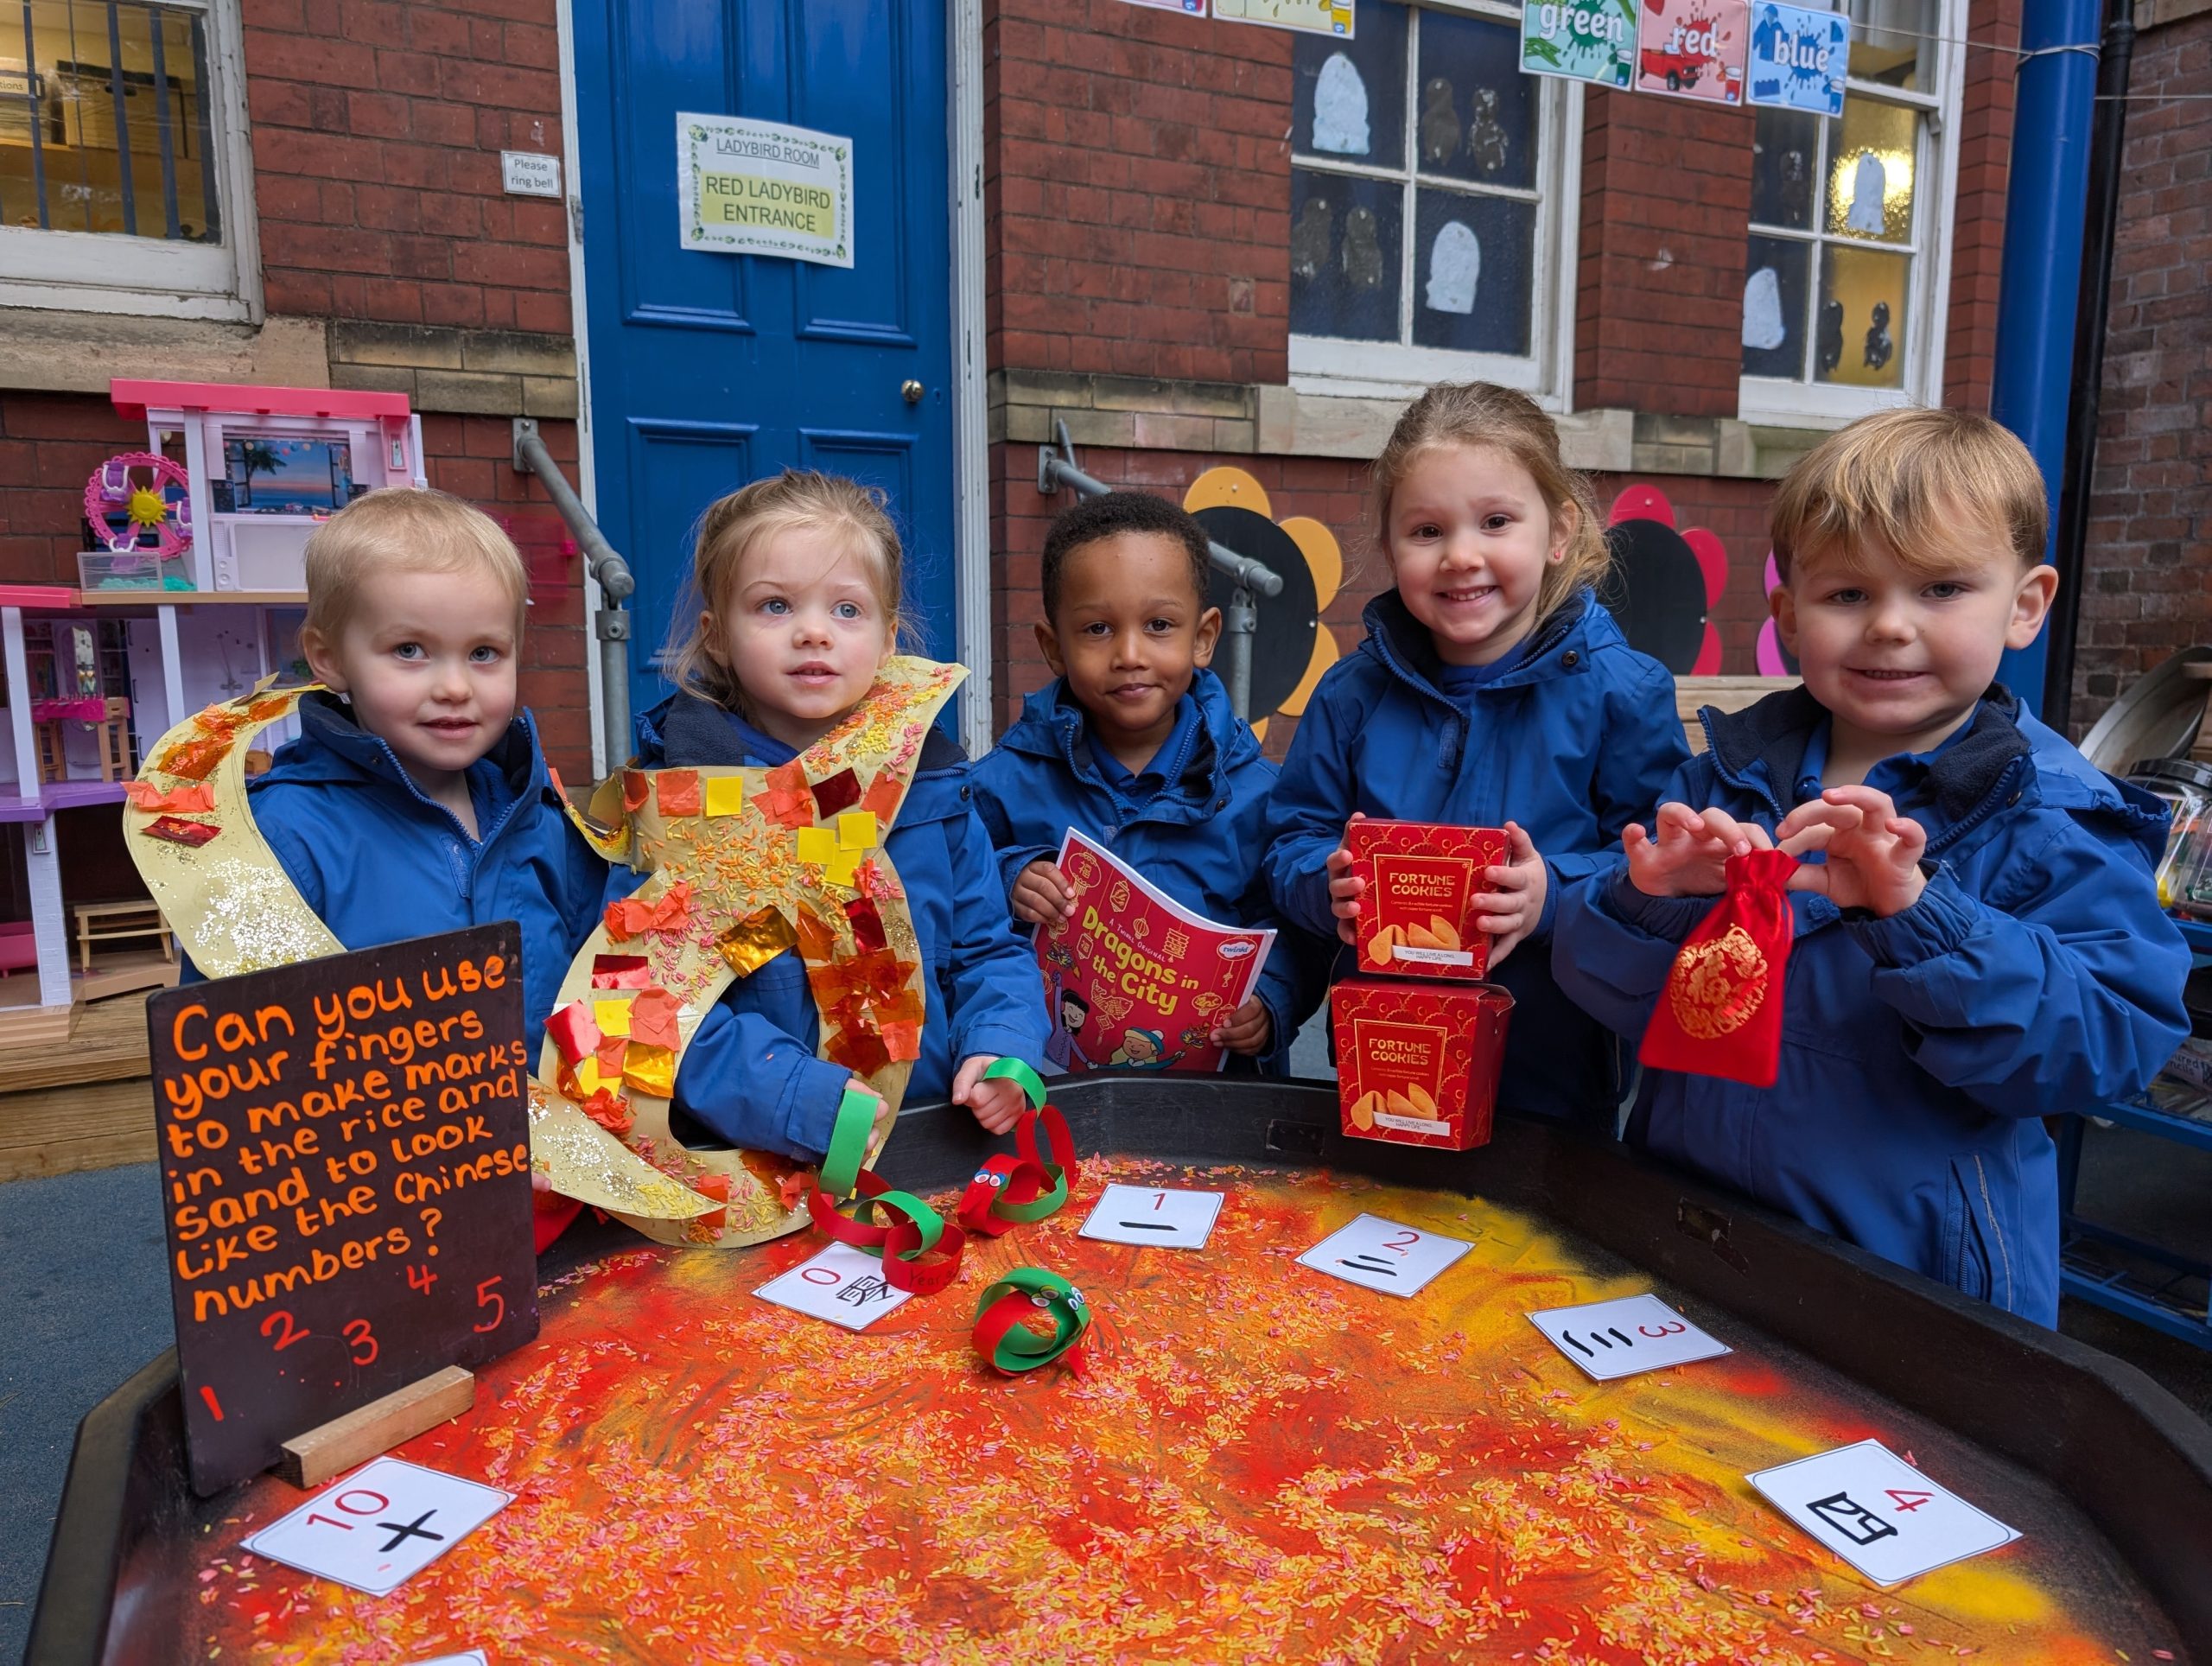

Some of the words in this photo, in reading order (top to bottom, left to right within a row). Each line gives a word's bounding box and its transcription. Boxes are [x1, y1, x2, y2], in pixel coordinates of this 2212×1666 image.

[1539, 3, 1624, 41] green
[1670, 21, 1719, 58] red
[1772, 29, 1829, 72] blue
[514, 158, 548, 172] Please
[716, 138, 781, 158] LADYBIRD
[784, 147, 820, 168] ROOM
[512, 175, 532, 188] ring
[535, 177, 554, 188] bell
[706, 176, 744, 196] RED
[749, 180, 830, 210] LADYBIRD
[724, 203, 817, 232] ENTRANCE
[1389, 872, 1456, 886] FORTUNE
[1391, 884, 1452, 897] COOKIES
[1082, 906, 1176, 985] Dragons
[1181, 974, 1199, 990] in
[1109, 917, 1115, 926] A
[1137, 941, 1166, 963] ORIGINAL
[1092, 954, 1116, 983] the
[1121, 972, 1178, 1015] City
[173, 1005, 296, 1061] Can
[314, 977, 413, 1040] you
[423, 955, 505, 1002] use
[1369, 1038, 1431, 1053] FORTUNE
[1370, 1051, 1428, 1065] COOKIES
[164, 1050, 289, 1121] your
[309, 1009, 484, 1080] fingers
[167, 1119, 229, 1158] to
[247, 1070, 391, 1133] make
[404, 1040, 526, 1091] marks
[168, 1167, 223, 1204] in
[238, 1128, 320, 1174] the
[340, 1097, 425, 1141] rice
[438, 1068, 519, 1114] and
[175, 1167, 310, 1241] sand
[326, 1150, 378, 1184] to
[296, 1186, 378, 1237] the
[394, 1143, 528, 1204] Chinese
[1151, 1192, 1167, 1211] 1
[1382, 1230, 1421, 1252] 2
[407, 1264, 437, 1295] 4
[801, 1268, 842, 1286] 0
[908, 1267, 941, 1288] Year
[474, 1275, 505, 1332] 5
[260, 1311, 310, 1351] 2
[342, 1319, 378, 1365] 3
[1638, 1320, 1687, 1339] 3
[200, 1386, 224, 1421] 1
[306, 1490, 390, 1531] 10
[1883, 1489, 1936, 1512] 4
